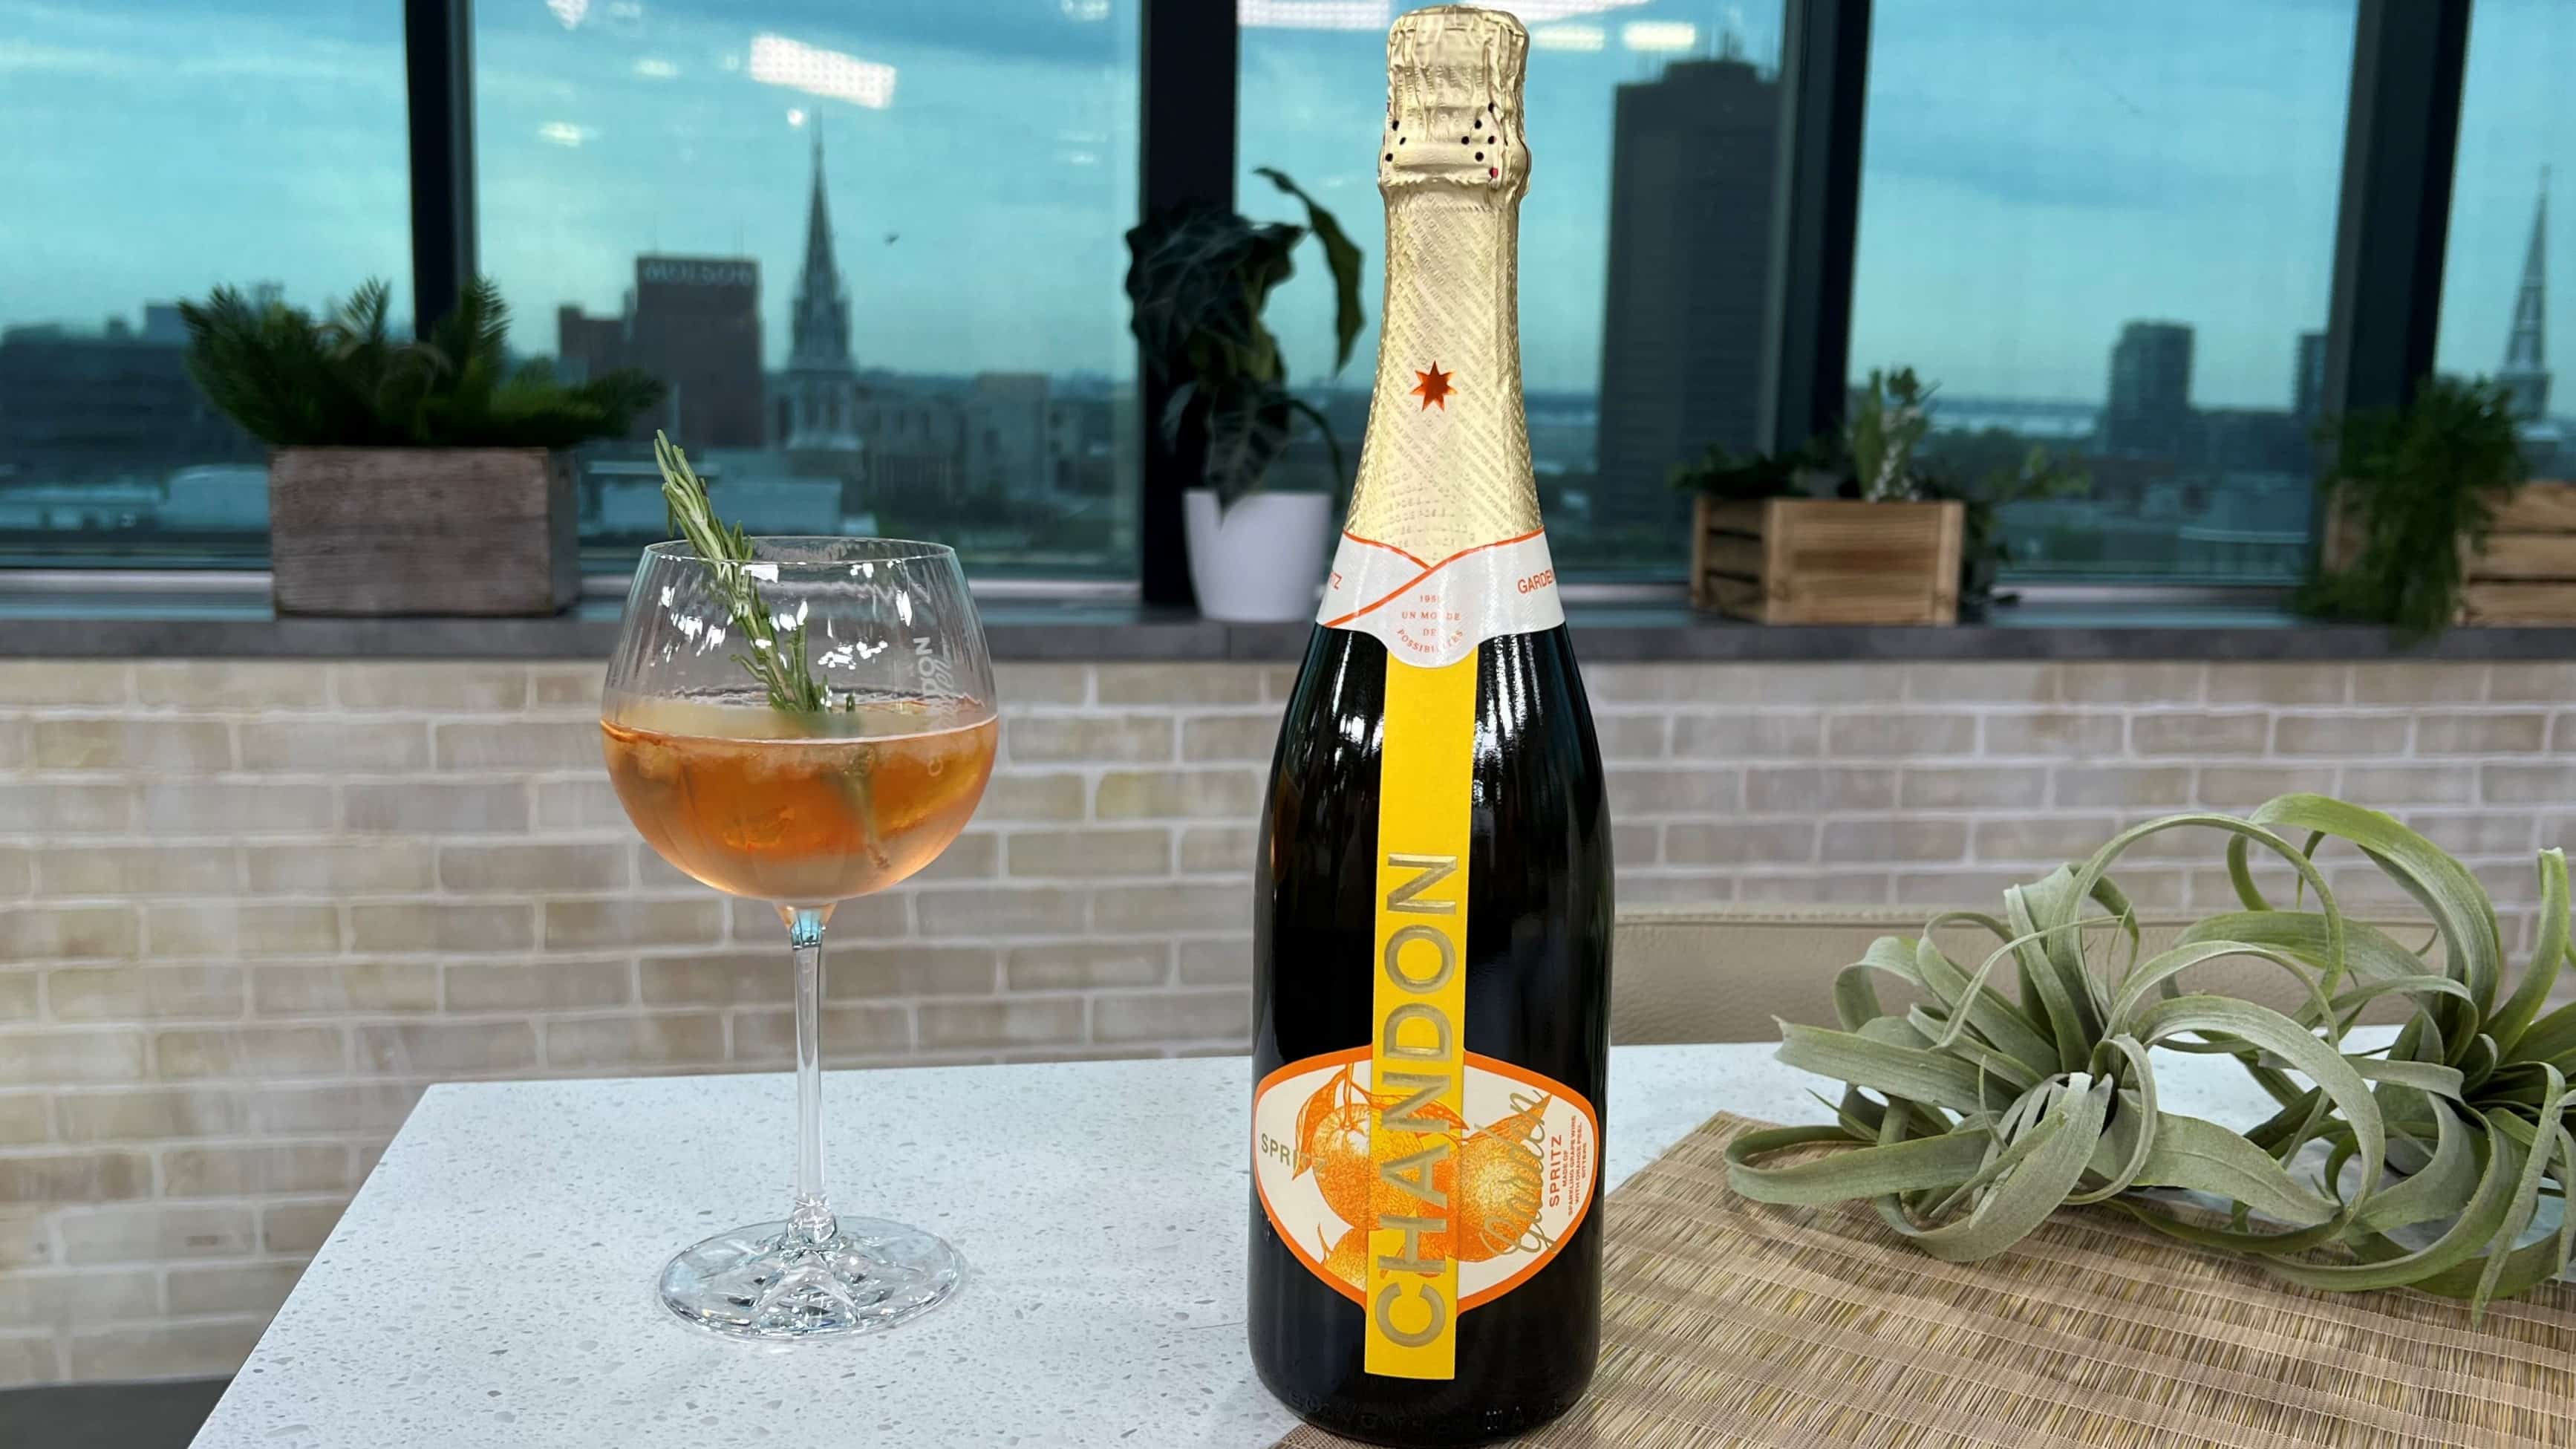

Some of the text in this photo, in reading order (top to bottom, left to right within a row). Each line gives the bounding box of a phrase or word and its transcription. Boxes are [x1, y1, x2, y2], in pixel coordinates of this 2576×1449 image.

[643, 263, 754, 284] MOLSON
[1401, 611, 1461, 621] UN MODE
[1375, 853, 1458, 1349] CHANDON
[1473, 1090, 1559, 1255] Garden
[1548, 1134, 1562, 1208] SPRITZ
[1562, 1149, 1569, 1162] OF
